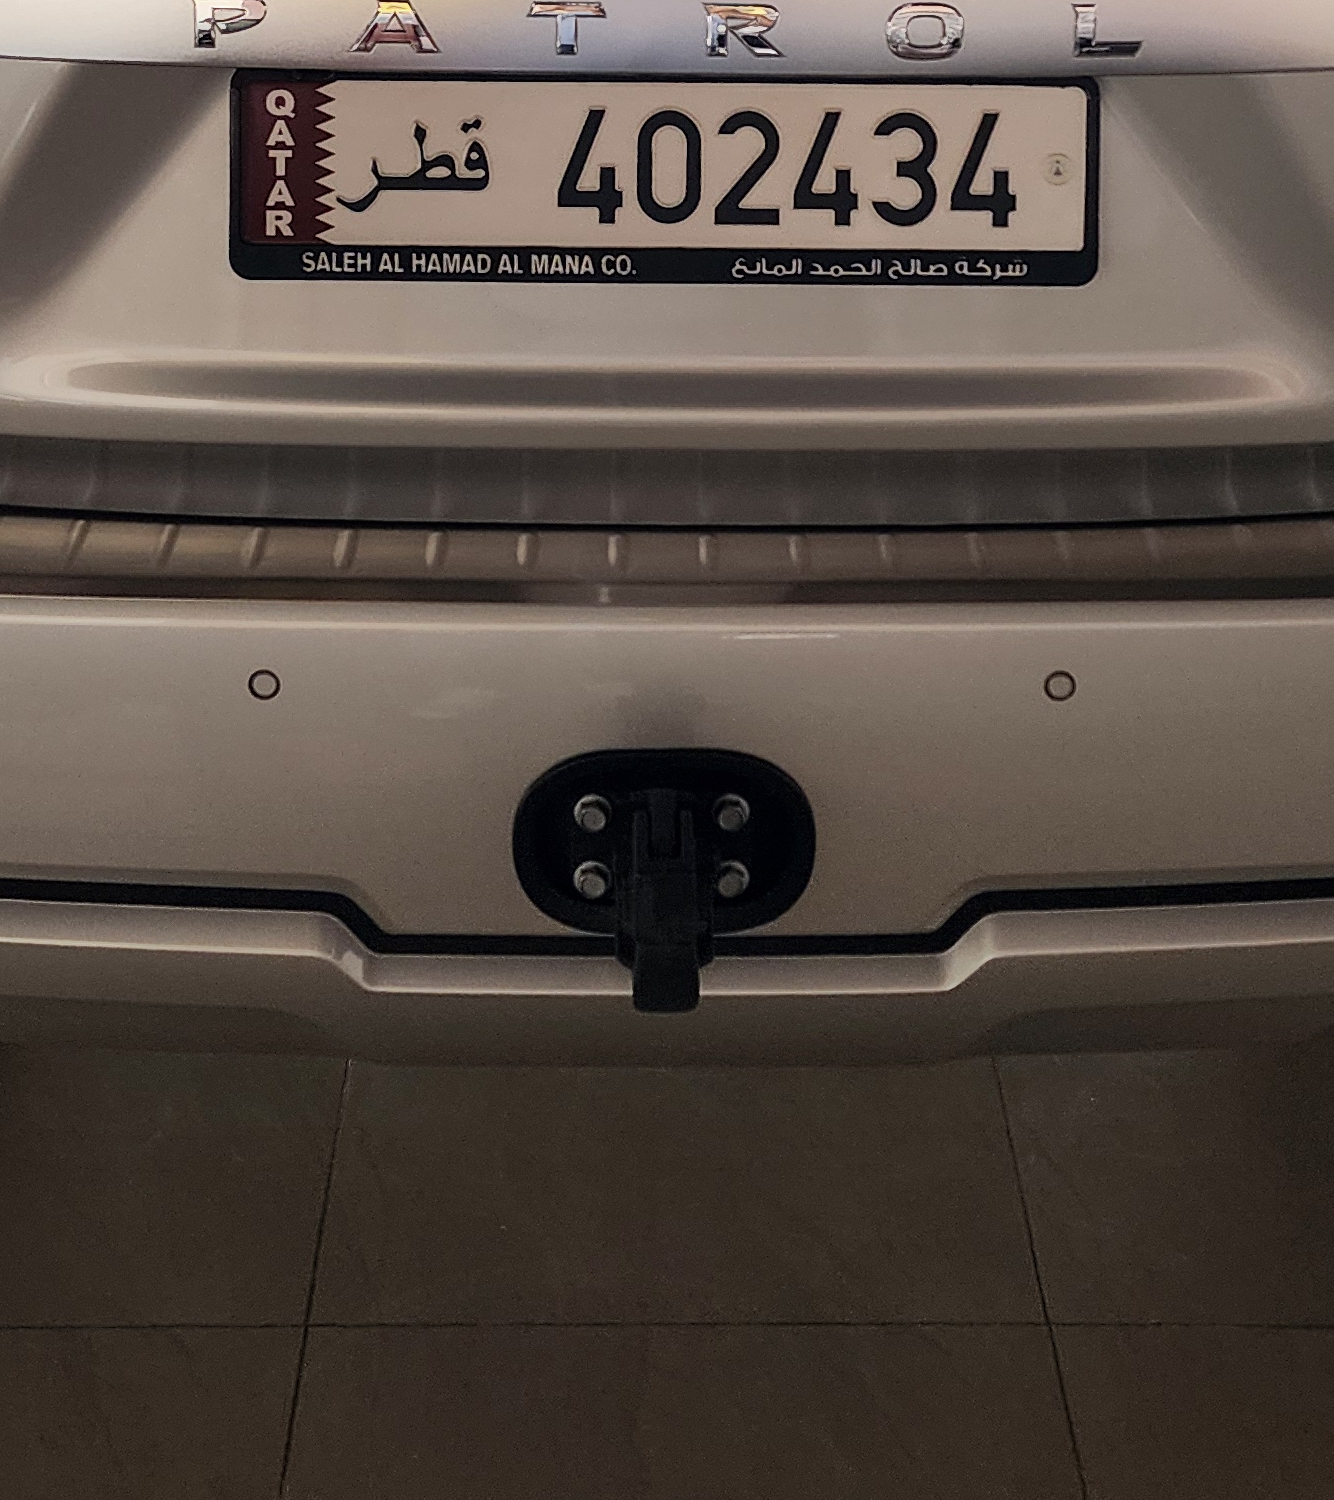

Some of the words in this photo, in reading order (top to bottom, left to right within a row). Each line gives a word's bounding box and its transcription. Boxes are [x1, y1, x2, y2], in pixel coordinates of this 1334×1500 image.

[265, 88, 296, 238] QATAR
[335, 117, 490, 213] قطر
[557, 108, 1018, 228] 402434
[301, 252, 371, 273] SALEH
[378, 253, 404, 273] AL
[411, 253, 491, 275] HAMAD
[497, 254, 524, 275] AL
[530, 254, 595, 275] MANA
[601, 255, 638, 276] CO.
[731, 257, 803, 279] المانع
[809, 258, 882, 277] الحمد
[888, 258, 948, 279] صالح
[954, 256, 1029, 280] شركة
